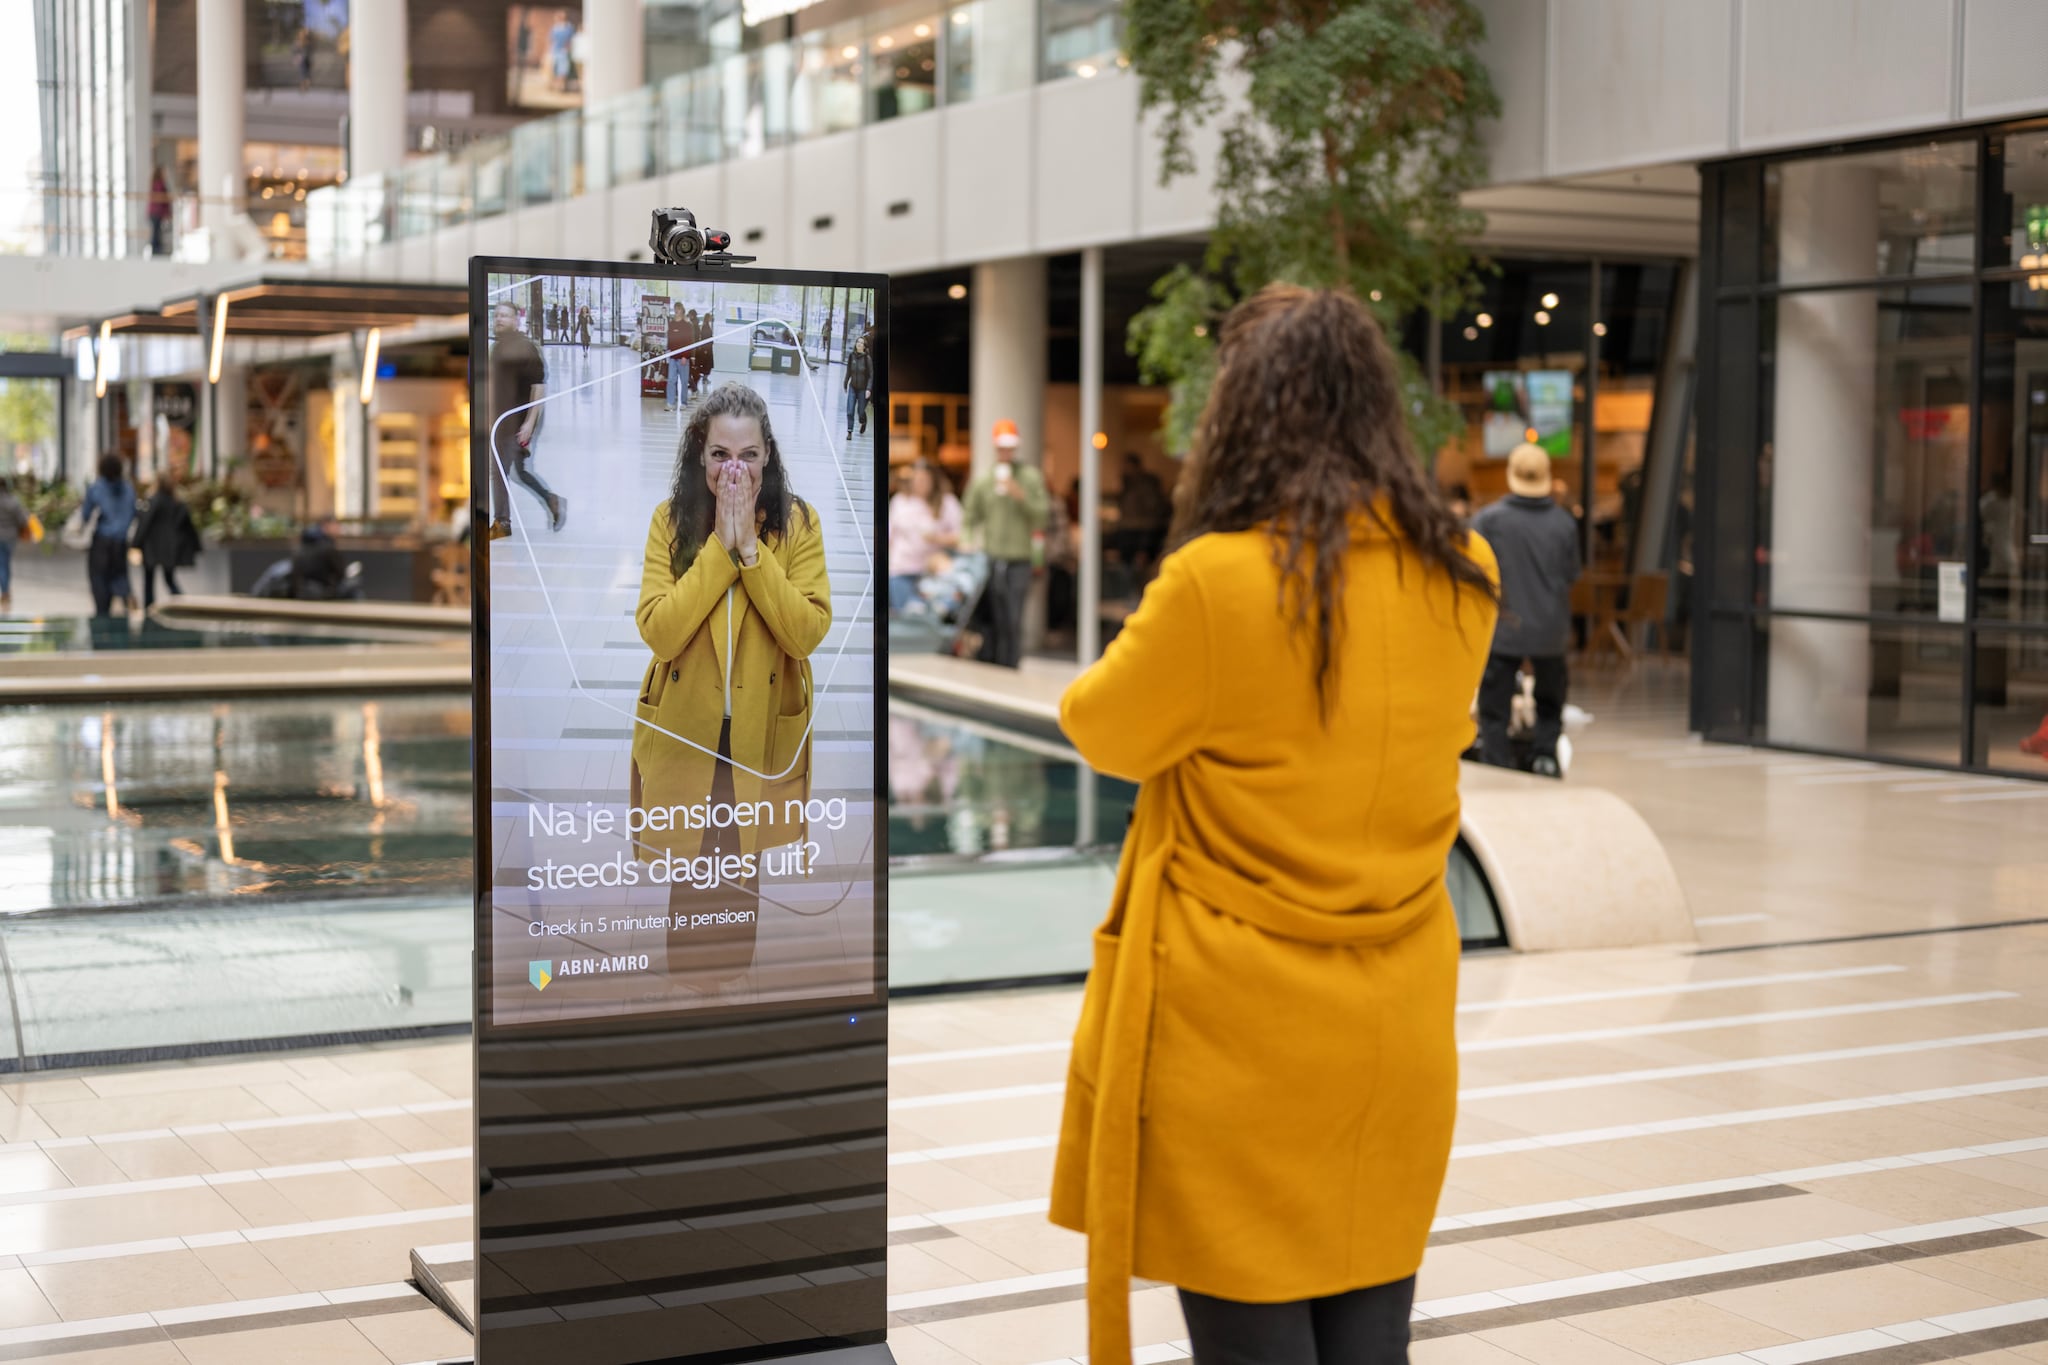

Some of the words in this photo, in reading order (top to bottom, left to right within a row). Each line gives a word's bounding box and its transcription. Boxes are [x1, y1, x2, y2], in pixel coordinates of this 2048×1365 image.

[528, 802, 577, 838] Na
[582, 801, 615, 844] je
[625, 795, 774, 841] pensioen
[785, 796, 847, 831] nog
[527, 851, 639, 892] steeds
[649, 846, 757, 890] dagjes
[766, 841, 821, 877] uit?
[528, 919, 577, 938] Check
[580, 918, 593, 934] in
[598, 917, 607, 933] 5
[611, 914, 671, 932] minuten
[673, 912, 688, 931] je
[691, 908, 756, 928] pensioen
